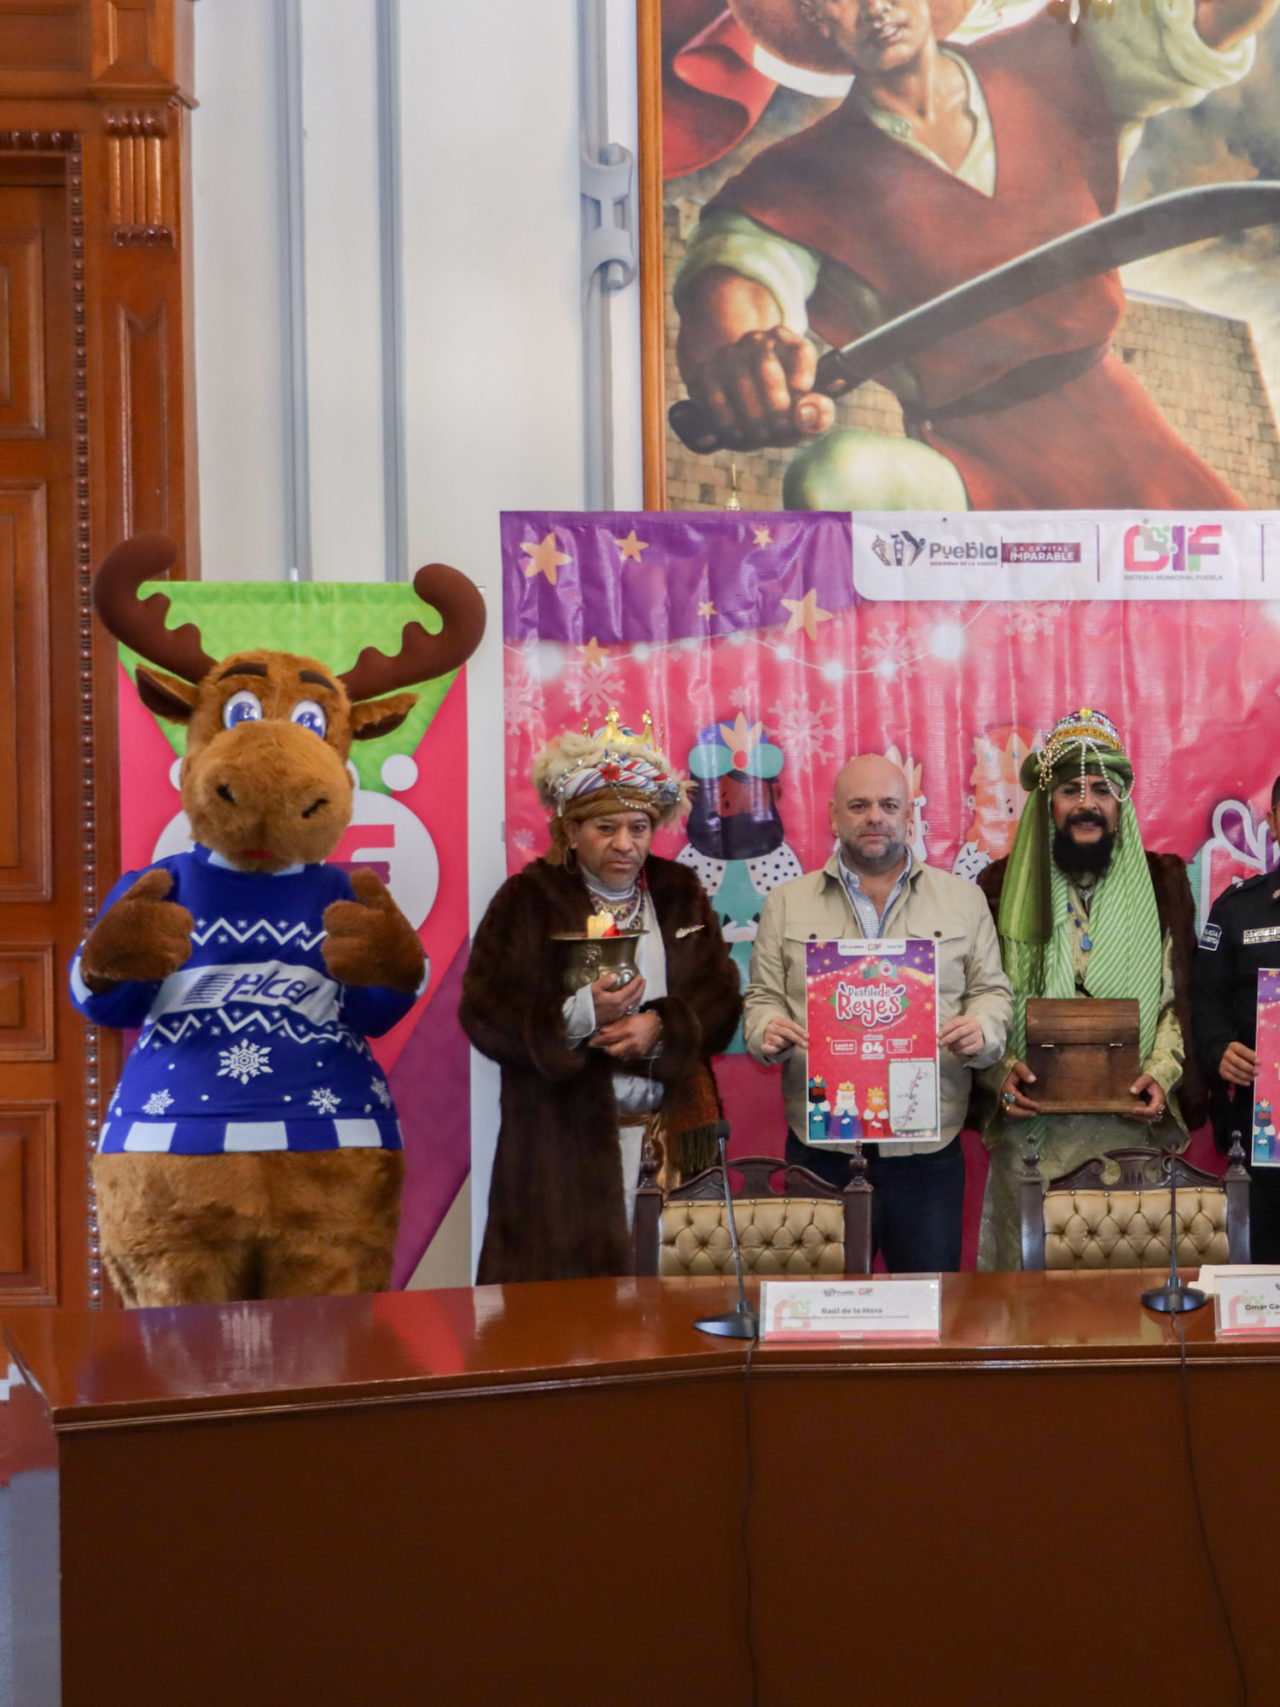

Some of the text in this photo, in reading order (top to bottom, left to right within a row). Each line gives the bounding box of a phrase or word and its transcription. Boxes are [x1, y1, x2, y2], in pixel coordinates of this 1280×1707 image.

[930, 541, 998, 559] Puebla
[1010, 552, 1075, 561] IMPARABLE
[837, 991, 901, 1026] Reyes
[862, 1041, 884, 1054] 04
[1245, 1303, 1267, 1311] Omar
